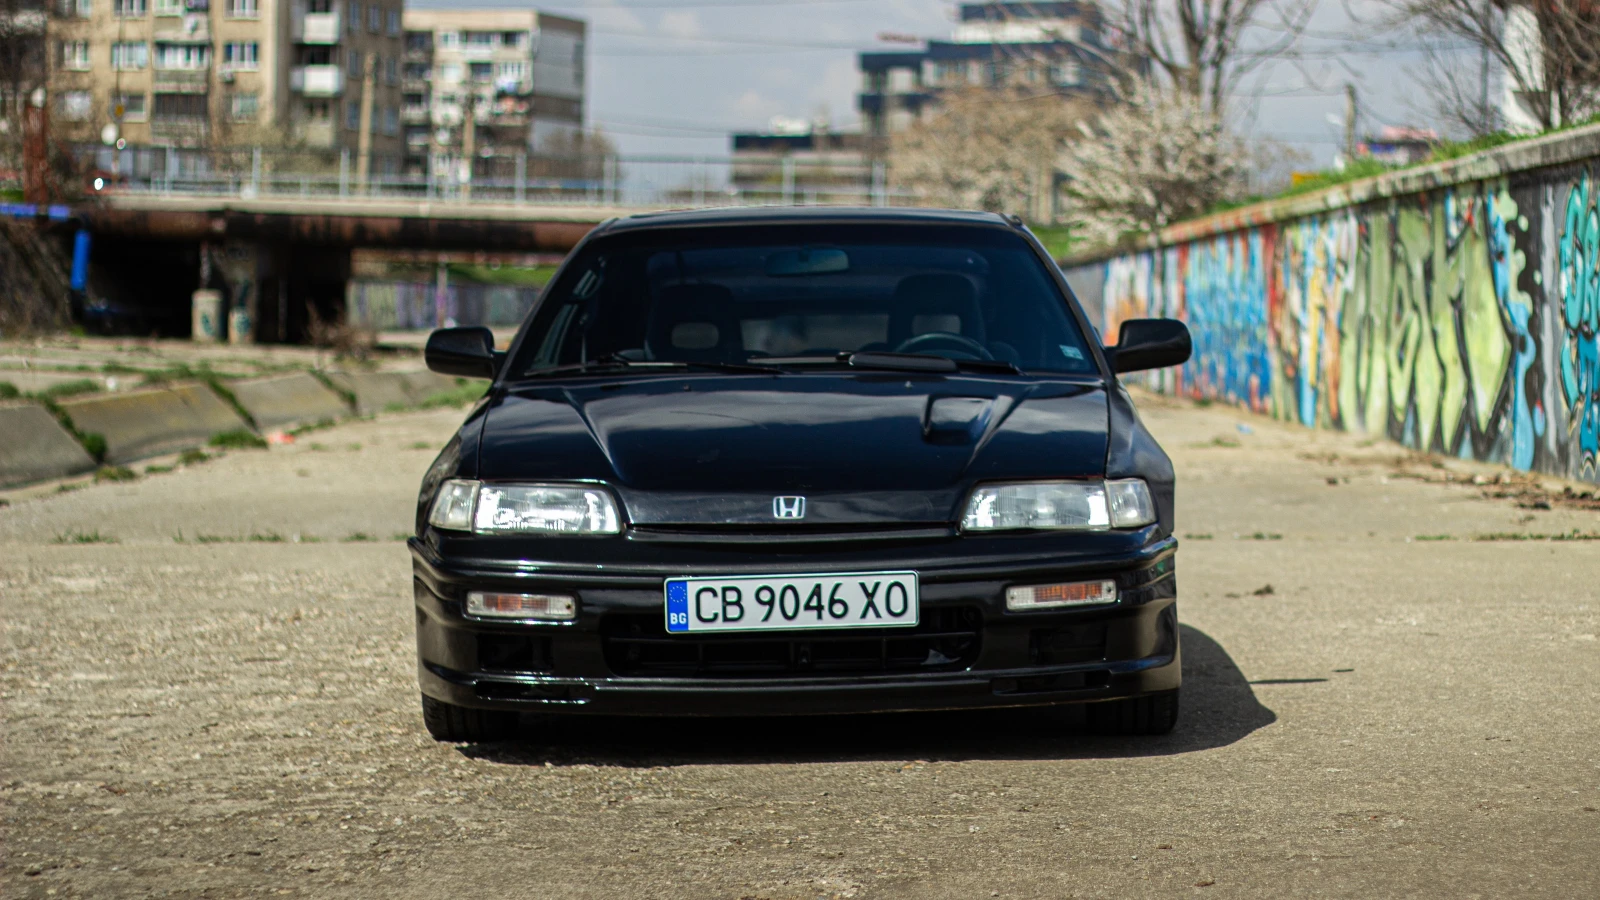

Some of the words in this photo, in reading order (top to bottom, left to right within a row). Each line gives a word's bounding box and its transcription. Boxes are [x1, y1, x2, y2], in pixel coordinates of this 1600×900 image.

[695, 585, 745, 623] CB
[754, 582, 849, 622] 9046
[858, 580, 909, 619] XO
[670, 613, 687, 625] BG
